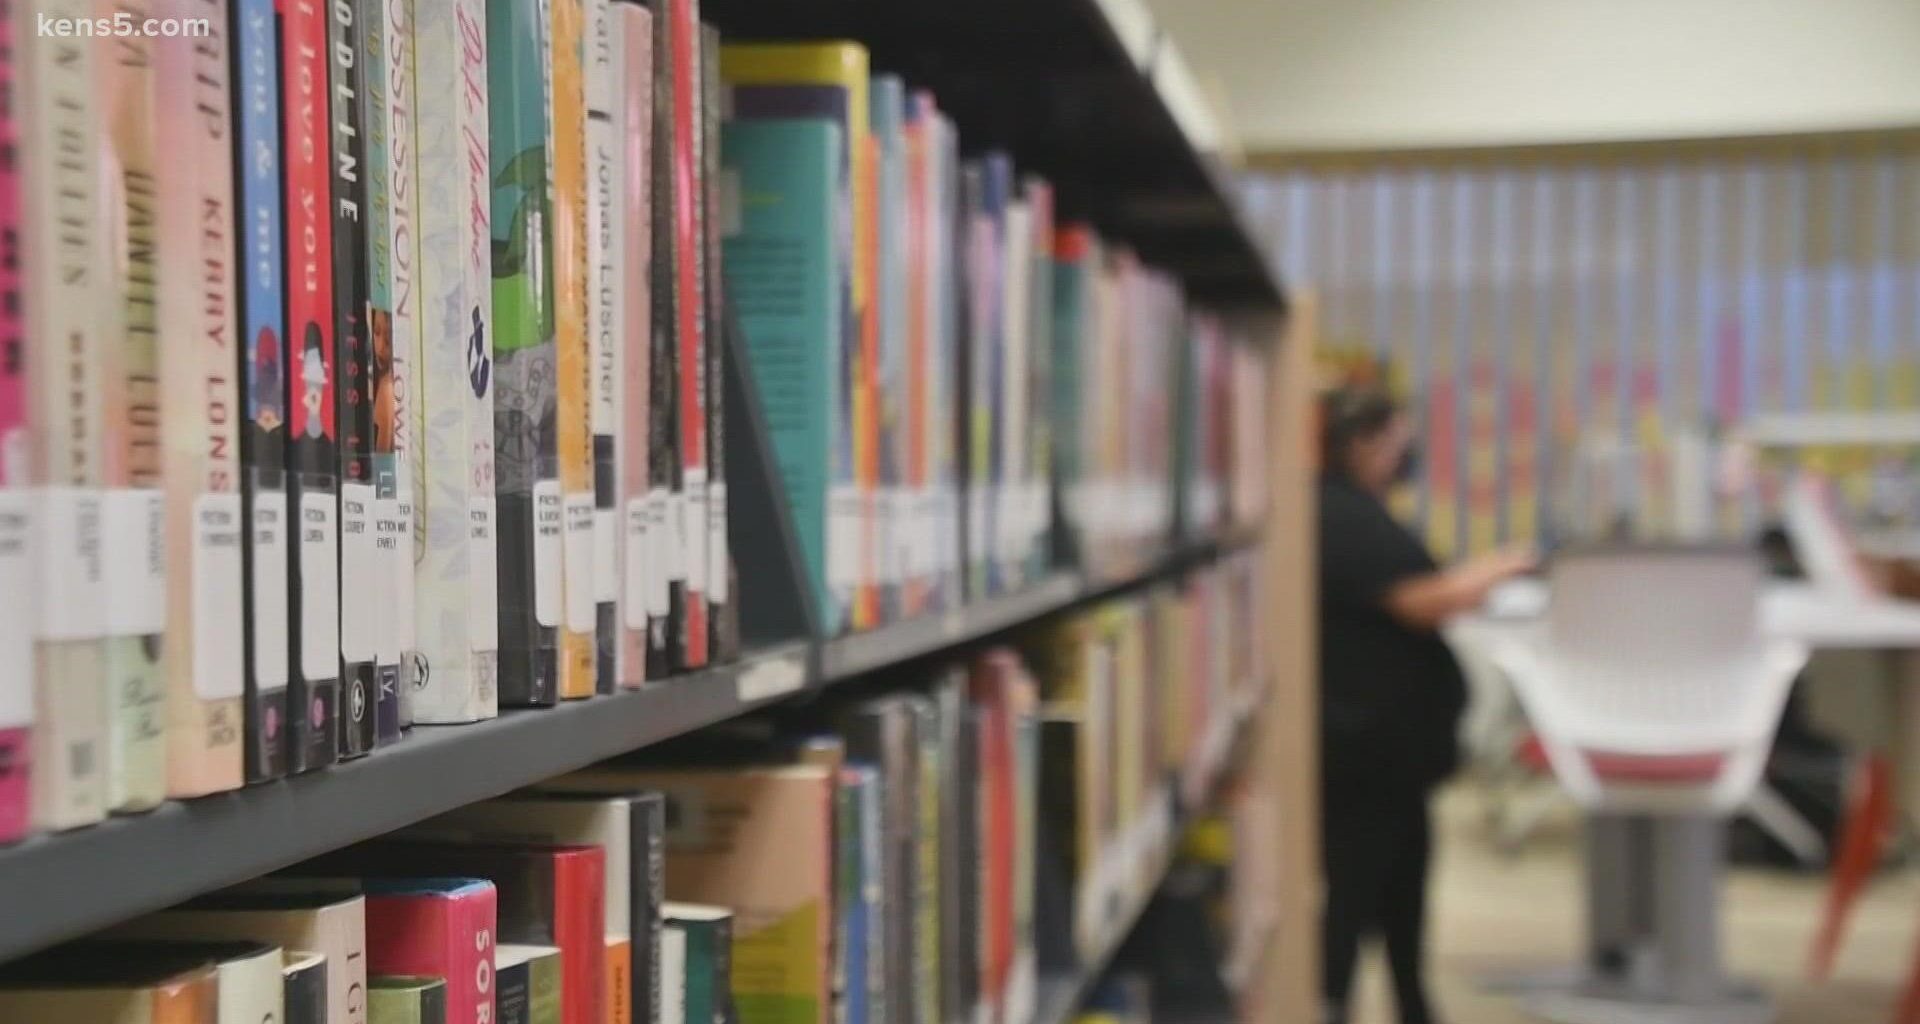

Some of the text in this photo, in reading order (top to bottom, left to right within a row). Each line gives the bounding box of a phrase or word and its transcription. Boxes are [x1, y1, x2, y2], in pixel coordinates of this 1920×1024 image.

[248, 12, 273, 290] you & me
[299, 44, 316, 167] love
[335, 0, 358, 224] ODLINE
[299, 187, 319, 293] you
[597, 145, 613, 250] Jonas
[204, 197, 226, 348] KERRY
[475, 928, 492, 1024] SOR
